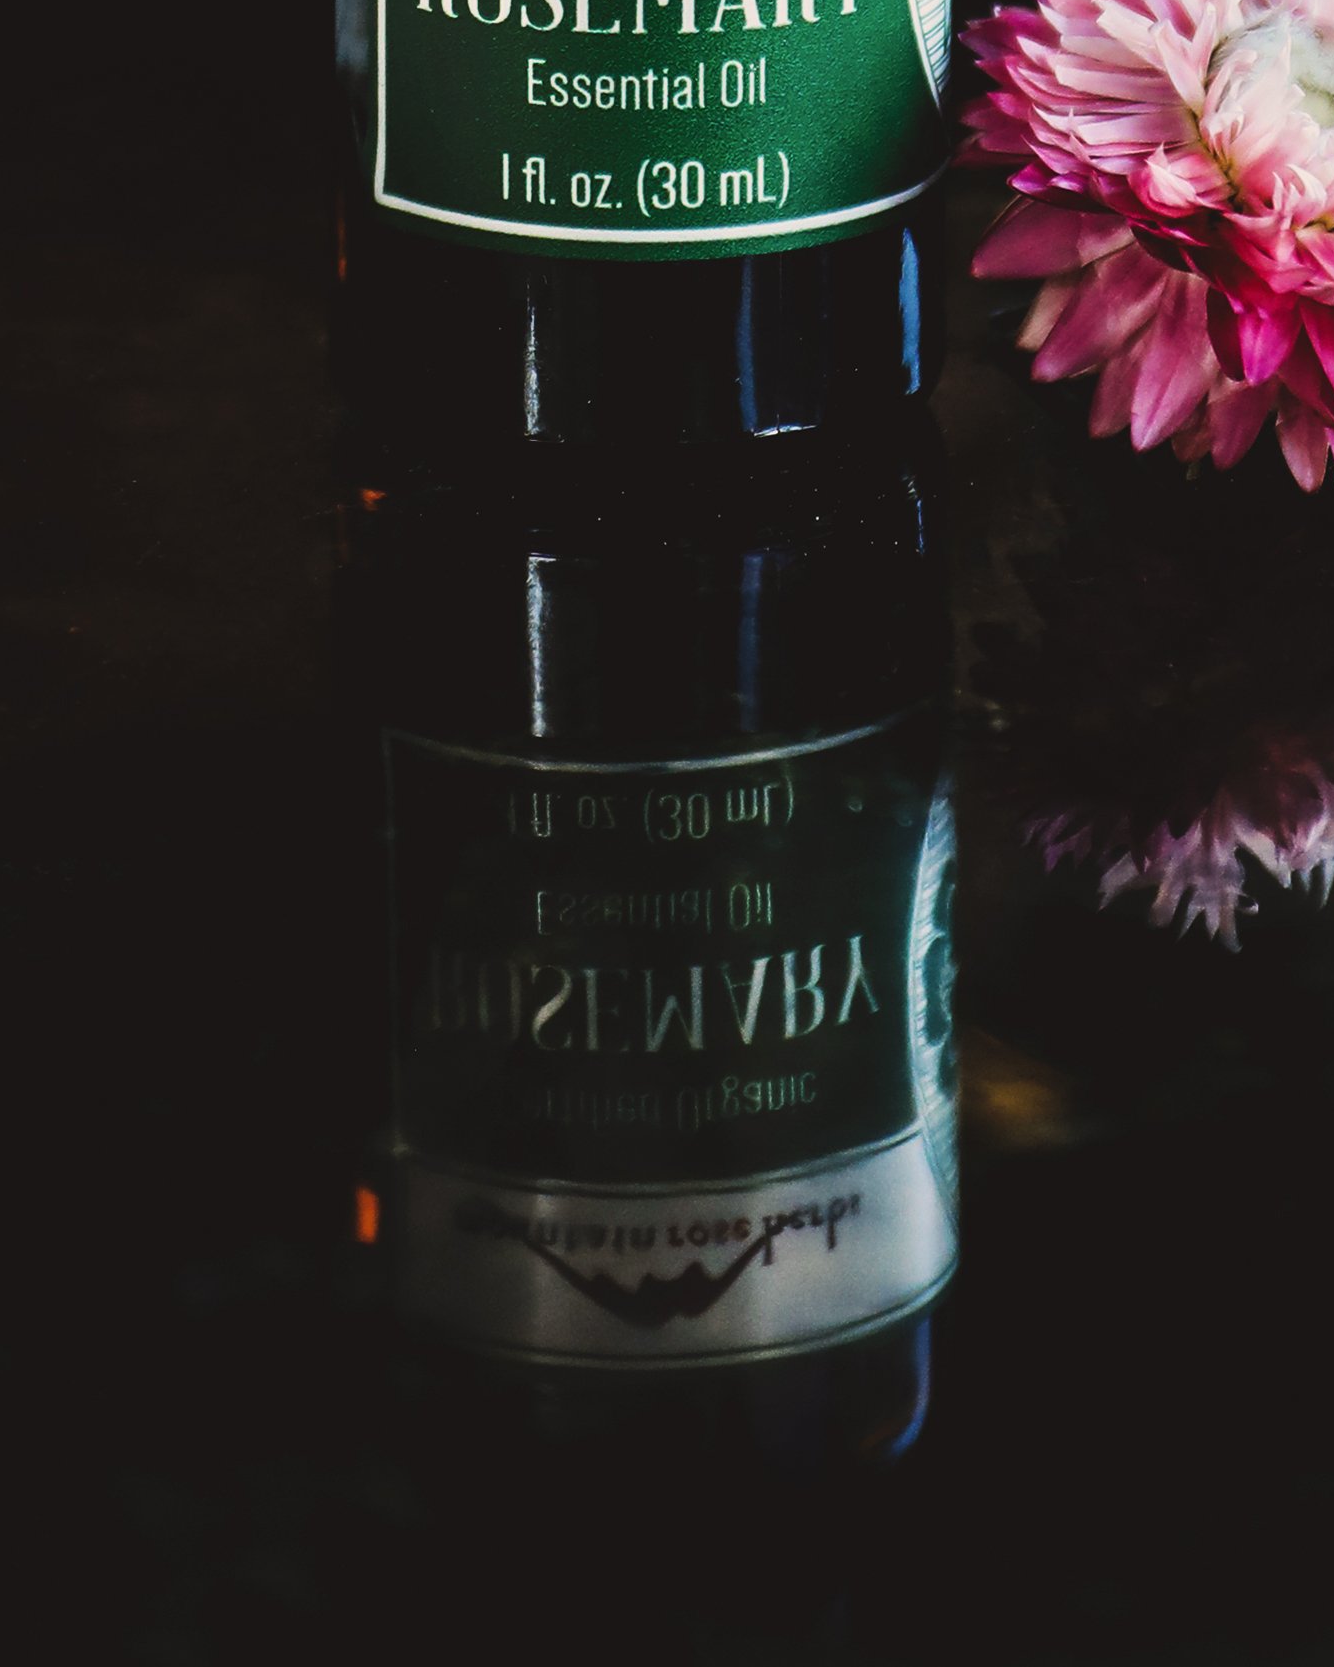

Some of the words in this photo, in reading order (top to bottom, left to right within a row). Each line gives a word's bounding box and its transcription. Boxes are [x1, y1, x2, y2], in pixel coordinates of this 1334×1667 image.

[527, 58, 706, 110] Essential
[720, 57, 767, 108] Oil
[521, 156, 557, 205] fl.
[570, 172, 623, 209] oz.
[636, 158, 706, 217] (30
[719, 151, 790, 209] mL)
